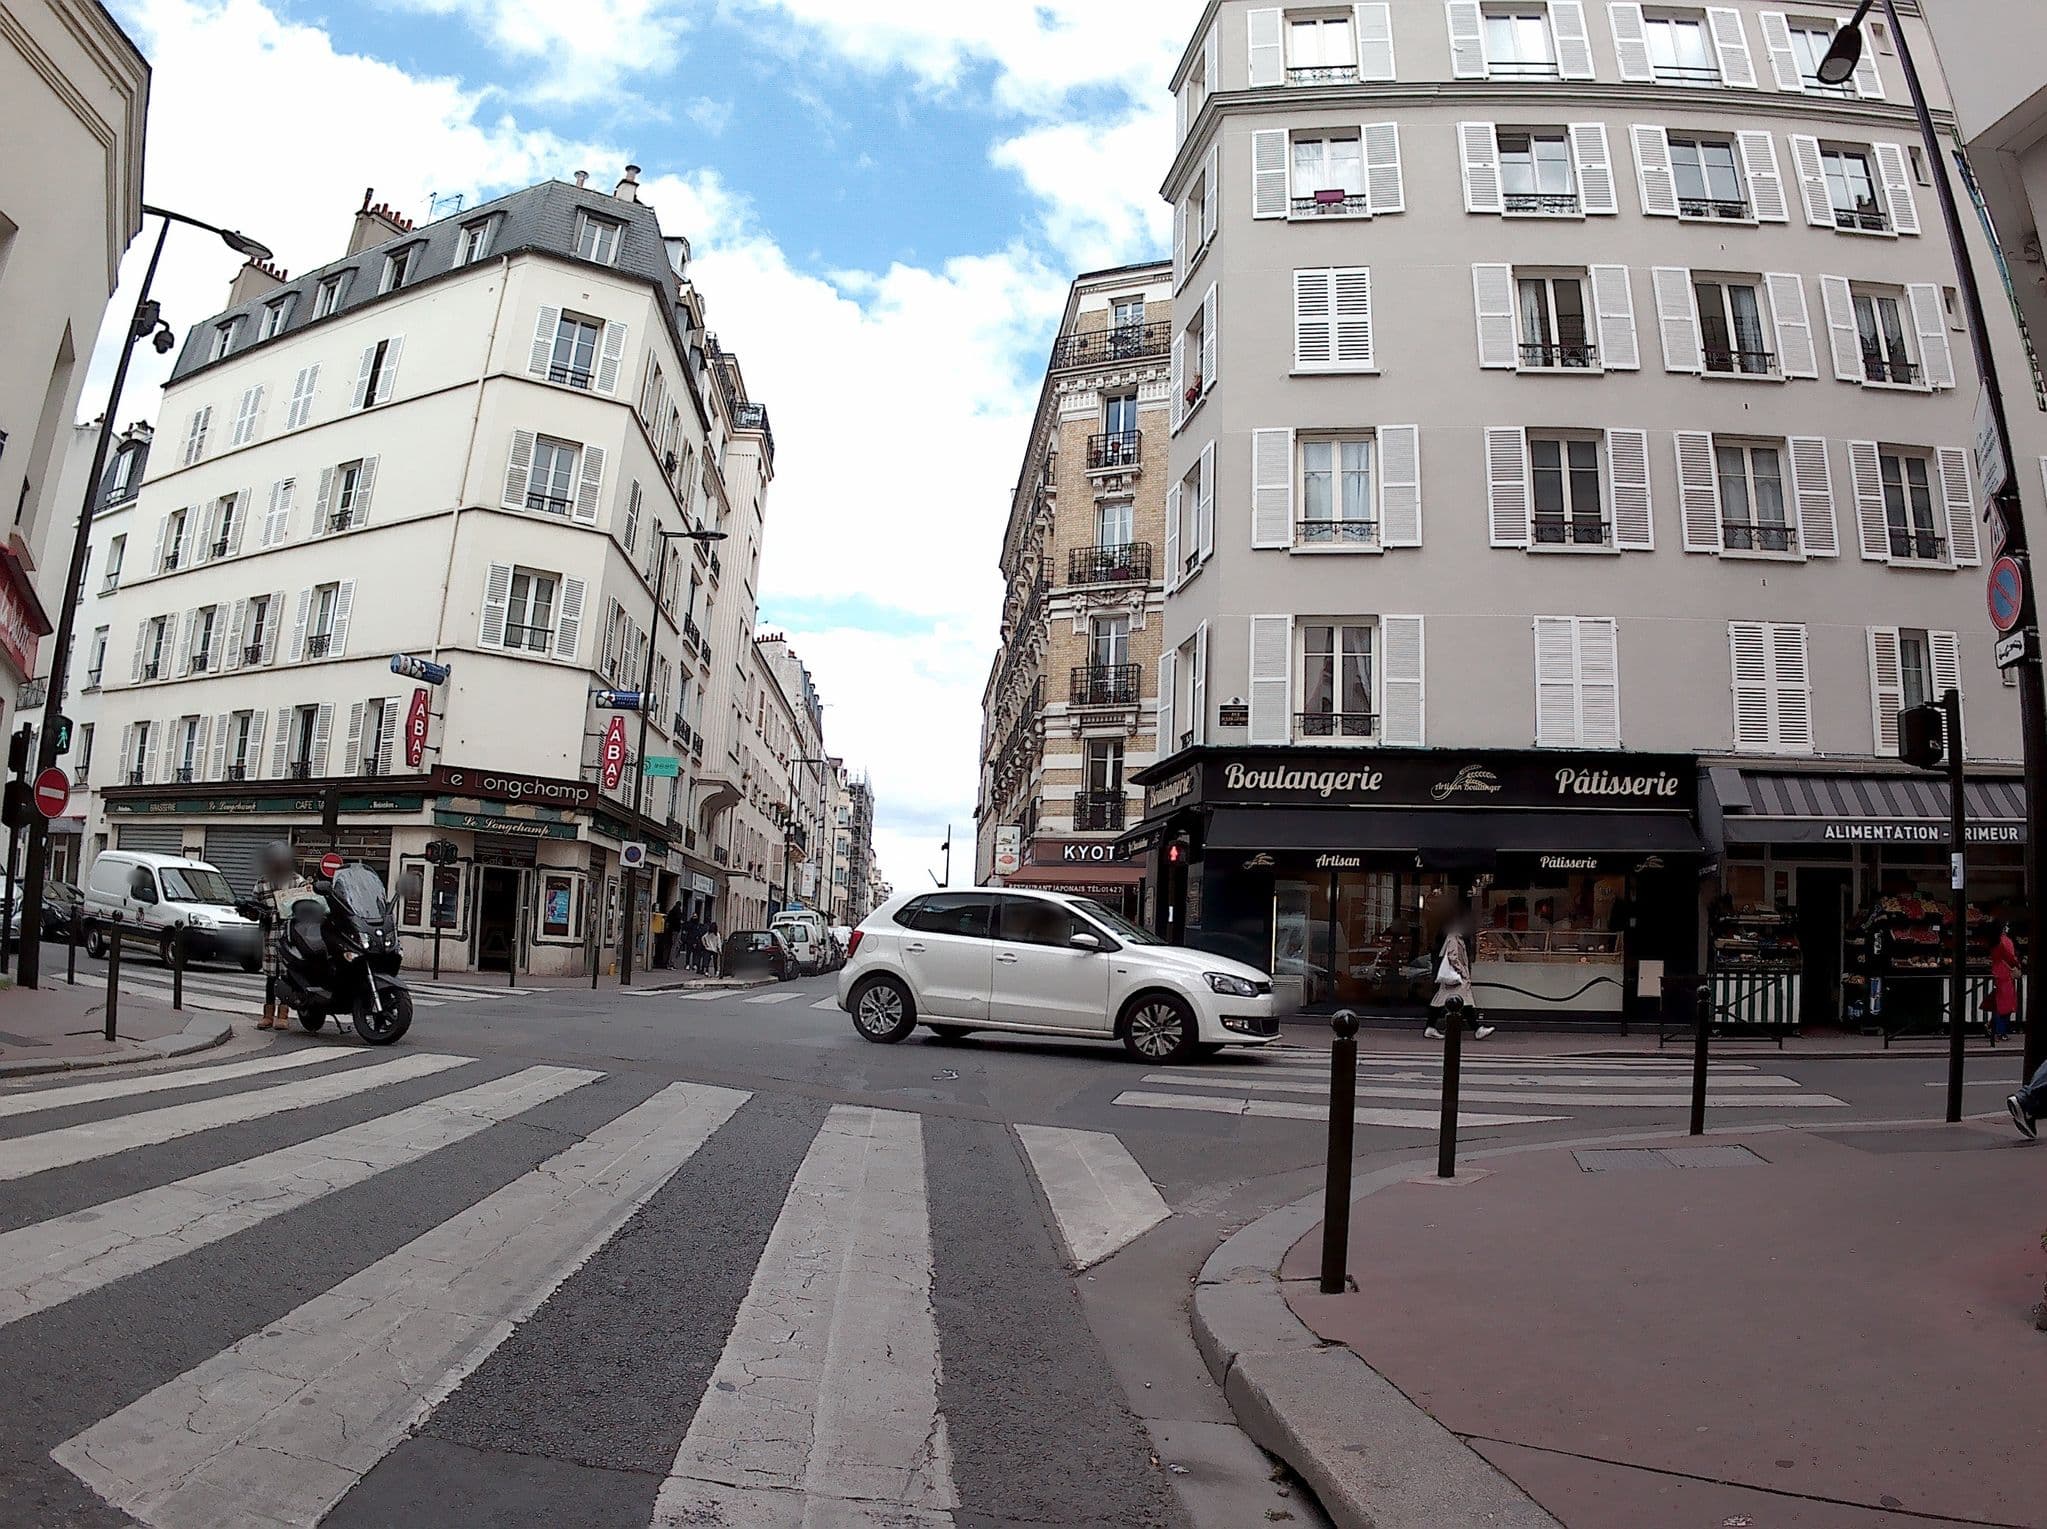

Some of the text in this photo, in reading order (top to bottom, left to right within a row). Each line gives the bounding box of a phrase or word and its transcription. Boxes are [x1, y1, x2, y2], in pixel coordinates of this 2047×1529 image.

[411, 691, 427, 764] TABAC
[606, 718, 622, 787] TABAC
[441, 767, 589, 806] Le Longchamp
[1225, 763, 1383, 798] Boulangerie
[1554, 767, 1679, 796] Pâtisserie
[462, 815, 551, 838] Le Longchamp
[1824, 825, 1939, 840] ALIMENTATION
[1964, 827, 2019, 841] RIMEUR
[1064, 845, 1128, 861] KYOT
[1315, 853, 1360, 869] Artisan
[1539, 855, 1598, 869] Pâtisserie
